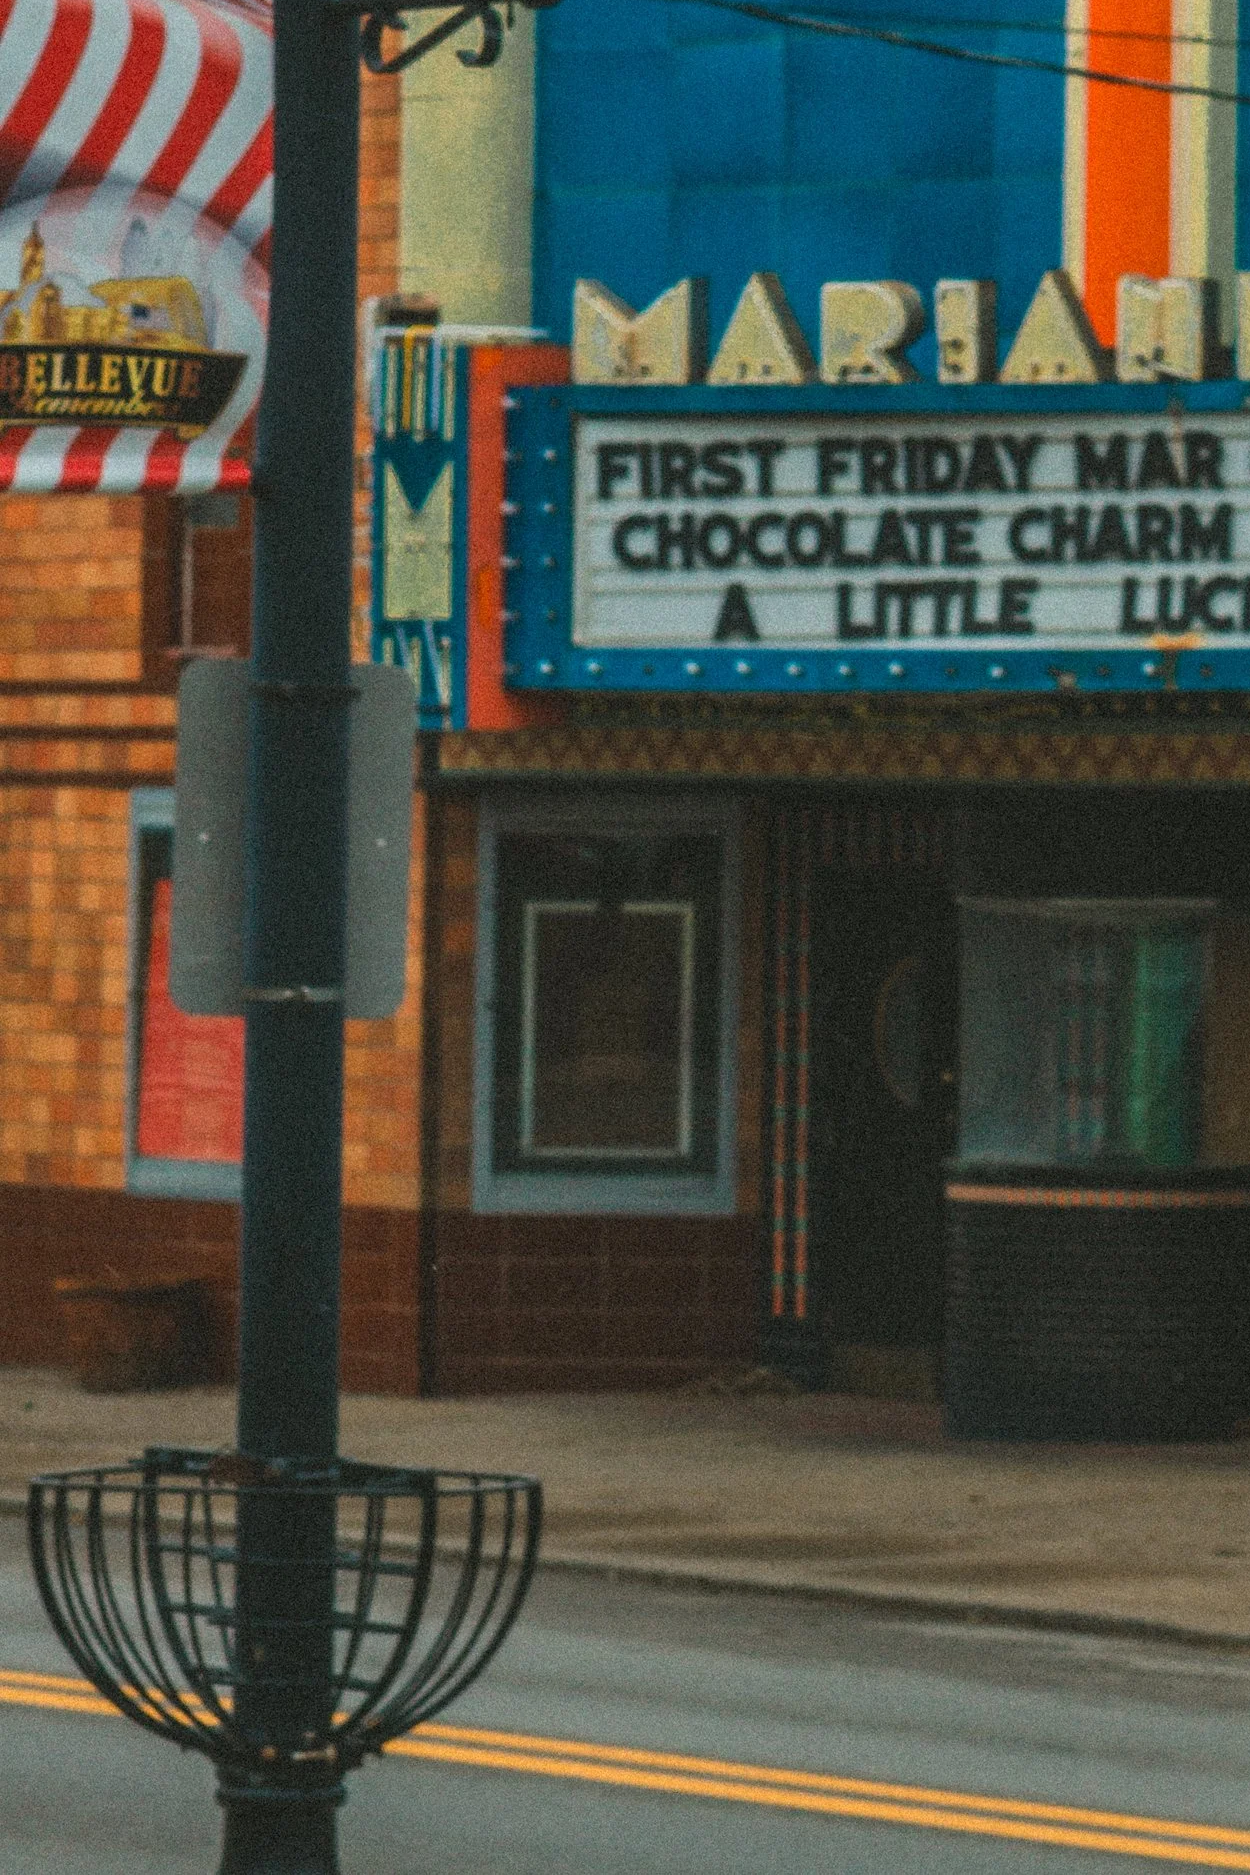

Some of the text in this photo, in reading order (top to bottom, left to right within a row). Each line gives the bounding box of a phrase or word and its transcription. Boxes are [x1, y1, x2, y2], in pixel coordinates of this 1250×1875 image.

[0, 351, 204, 398] BELLEVUE
[599, 438, 783, 500] FIRST
[815, 434, 1039, 496] FRIDAY
[1075, 429, 1224, 492] MAR
[613, 507, 983, 570] CHOCOLATE
[1009, 501, 1233, 565] CHARM
[713, 582, 761, 642] A
[837, 578, 1039, 640] LITTLE
